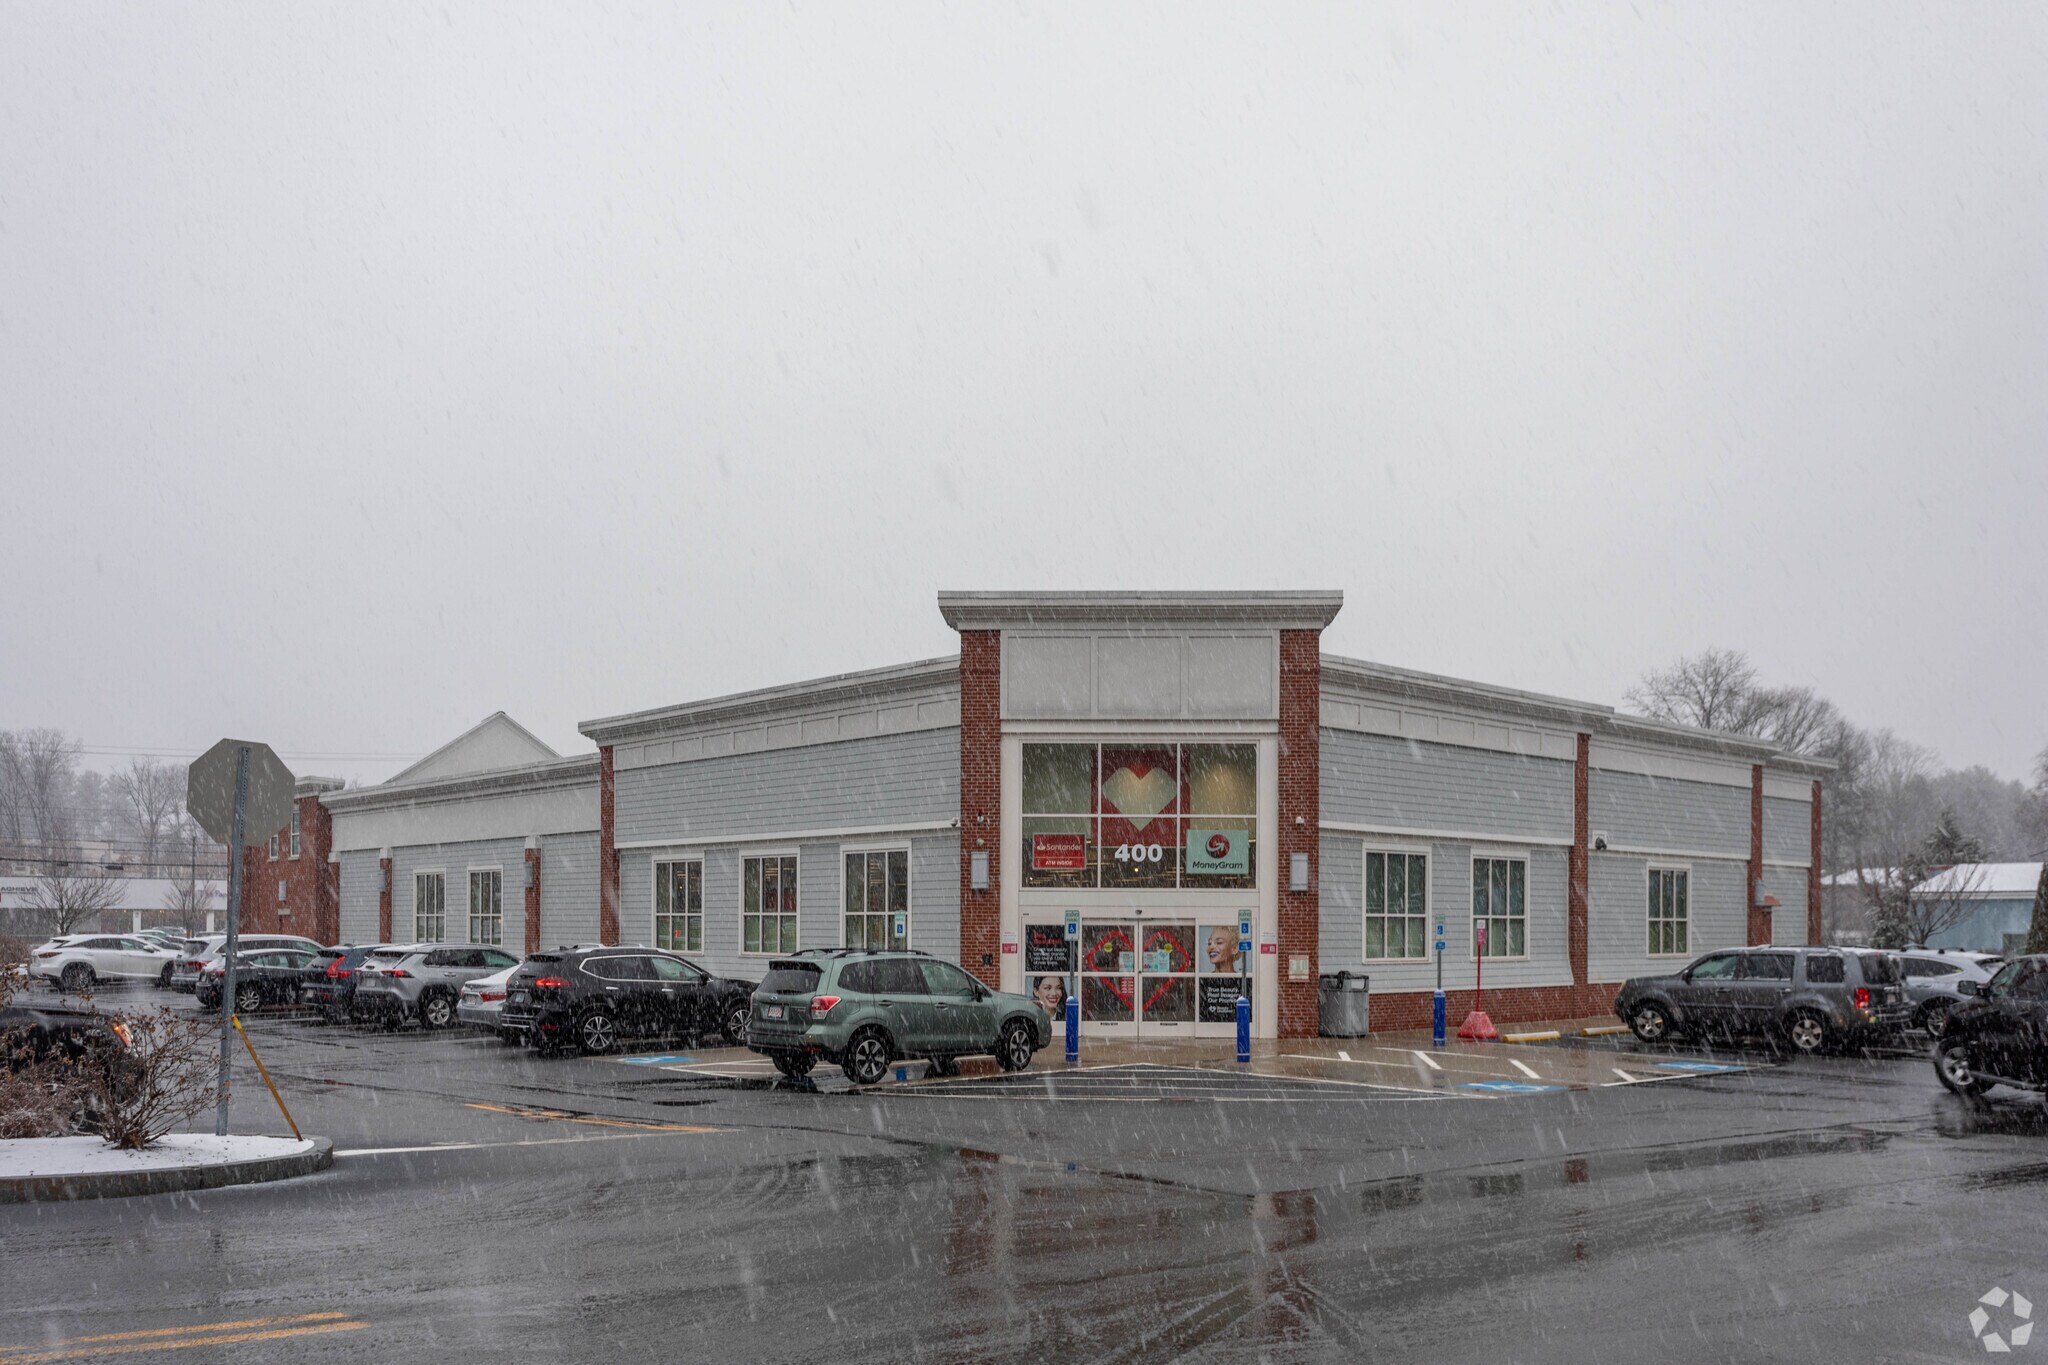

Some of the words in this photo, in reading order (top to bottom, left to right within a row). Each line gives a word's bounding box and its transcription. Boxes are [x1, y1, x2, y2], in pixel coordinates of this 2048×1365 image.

[1046, 843, 1082, 851] Santander
[1114, 843, 1163, 862] 400
[1192, 861, 1243, 870] MoneyGram
